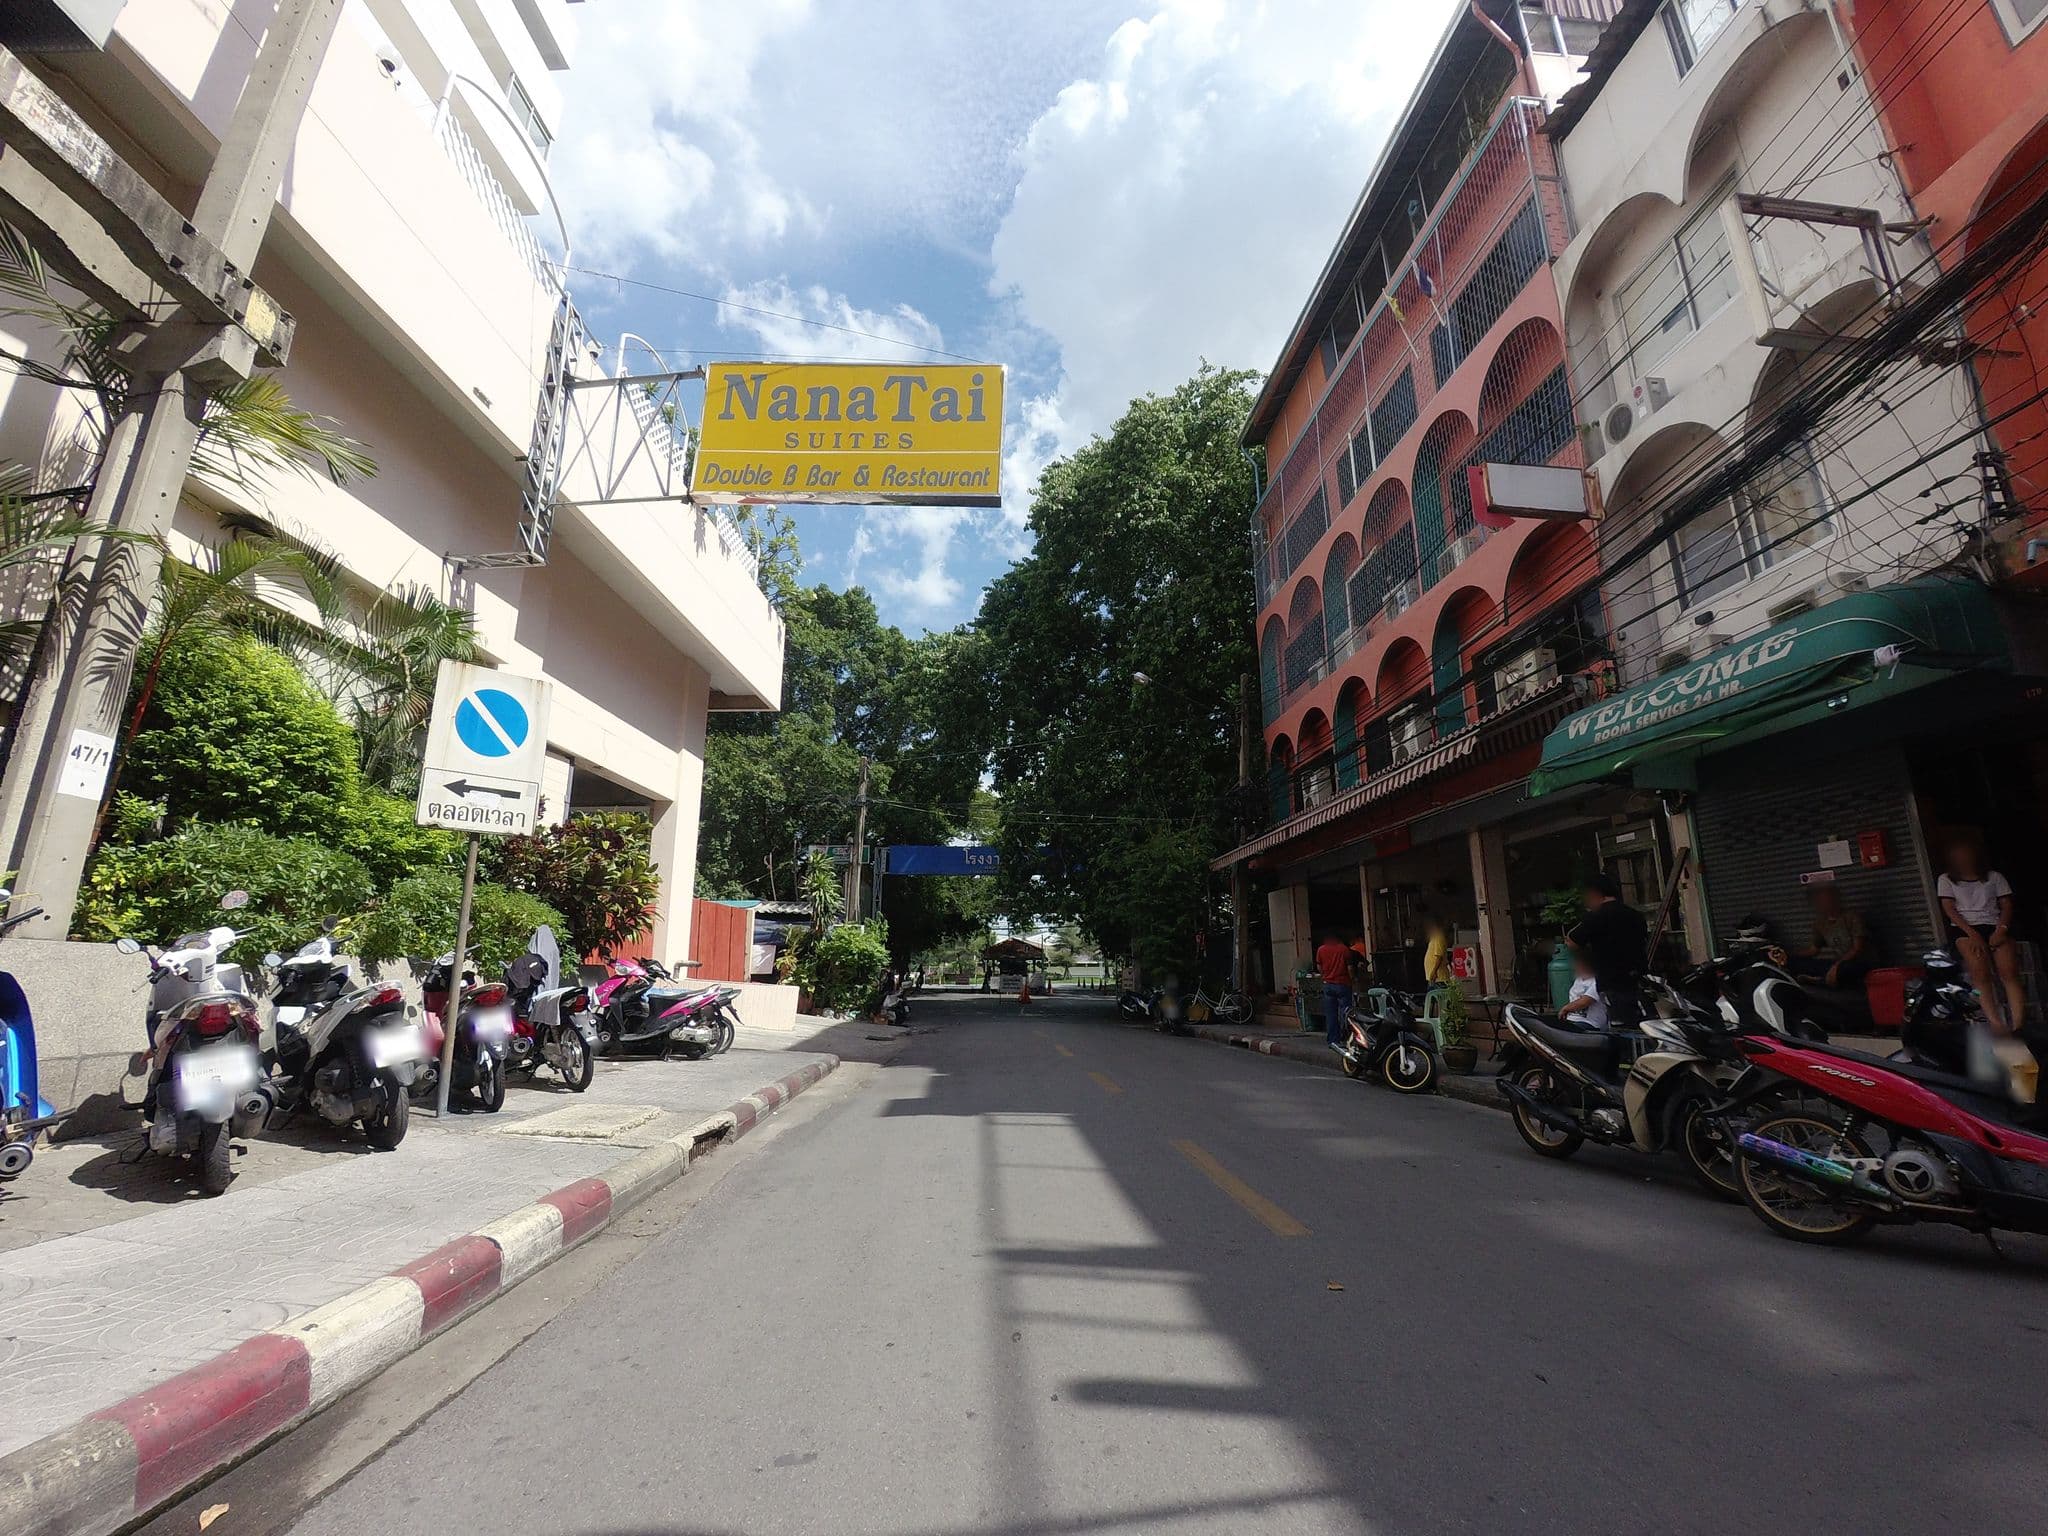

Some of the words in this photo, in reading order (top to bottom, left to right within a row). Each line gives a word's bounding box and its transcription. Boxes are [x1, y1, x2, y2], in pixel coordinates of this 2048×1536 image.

[785, 432, 914, 449] SUITES
[702, 462, 773, 486] Double
[783, 463, 798, 486] B
[806, 463, 841, 487] Bar
[853, 464, 870, 486] &
[881, 463, 991, 487] Restaurant
[1567, 627, 1798, 740] WELCOME
[1594, 722, 1632, 744] ROOM
[1635, 699, 1688, 727] SERVICE
[1692, 691, 1713, 708] 24
[1719, 679, 1745, 699] HR.
[71, 744, 109, 767] 47/1
[428, 802, 526, 828] ตลอดเวลา
